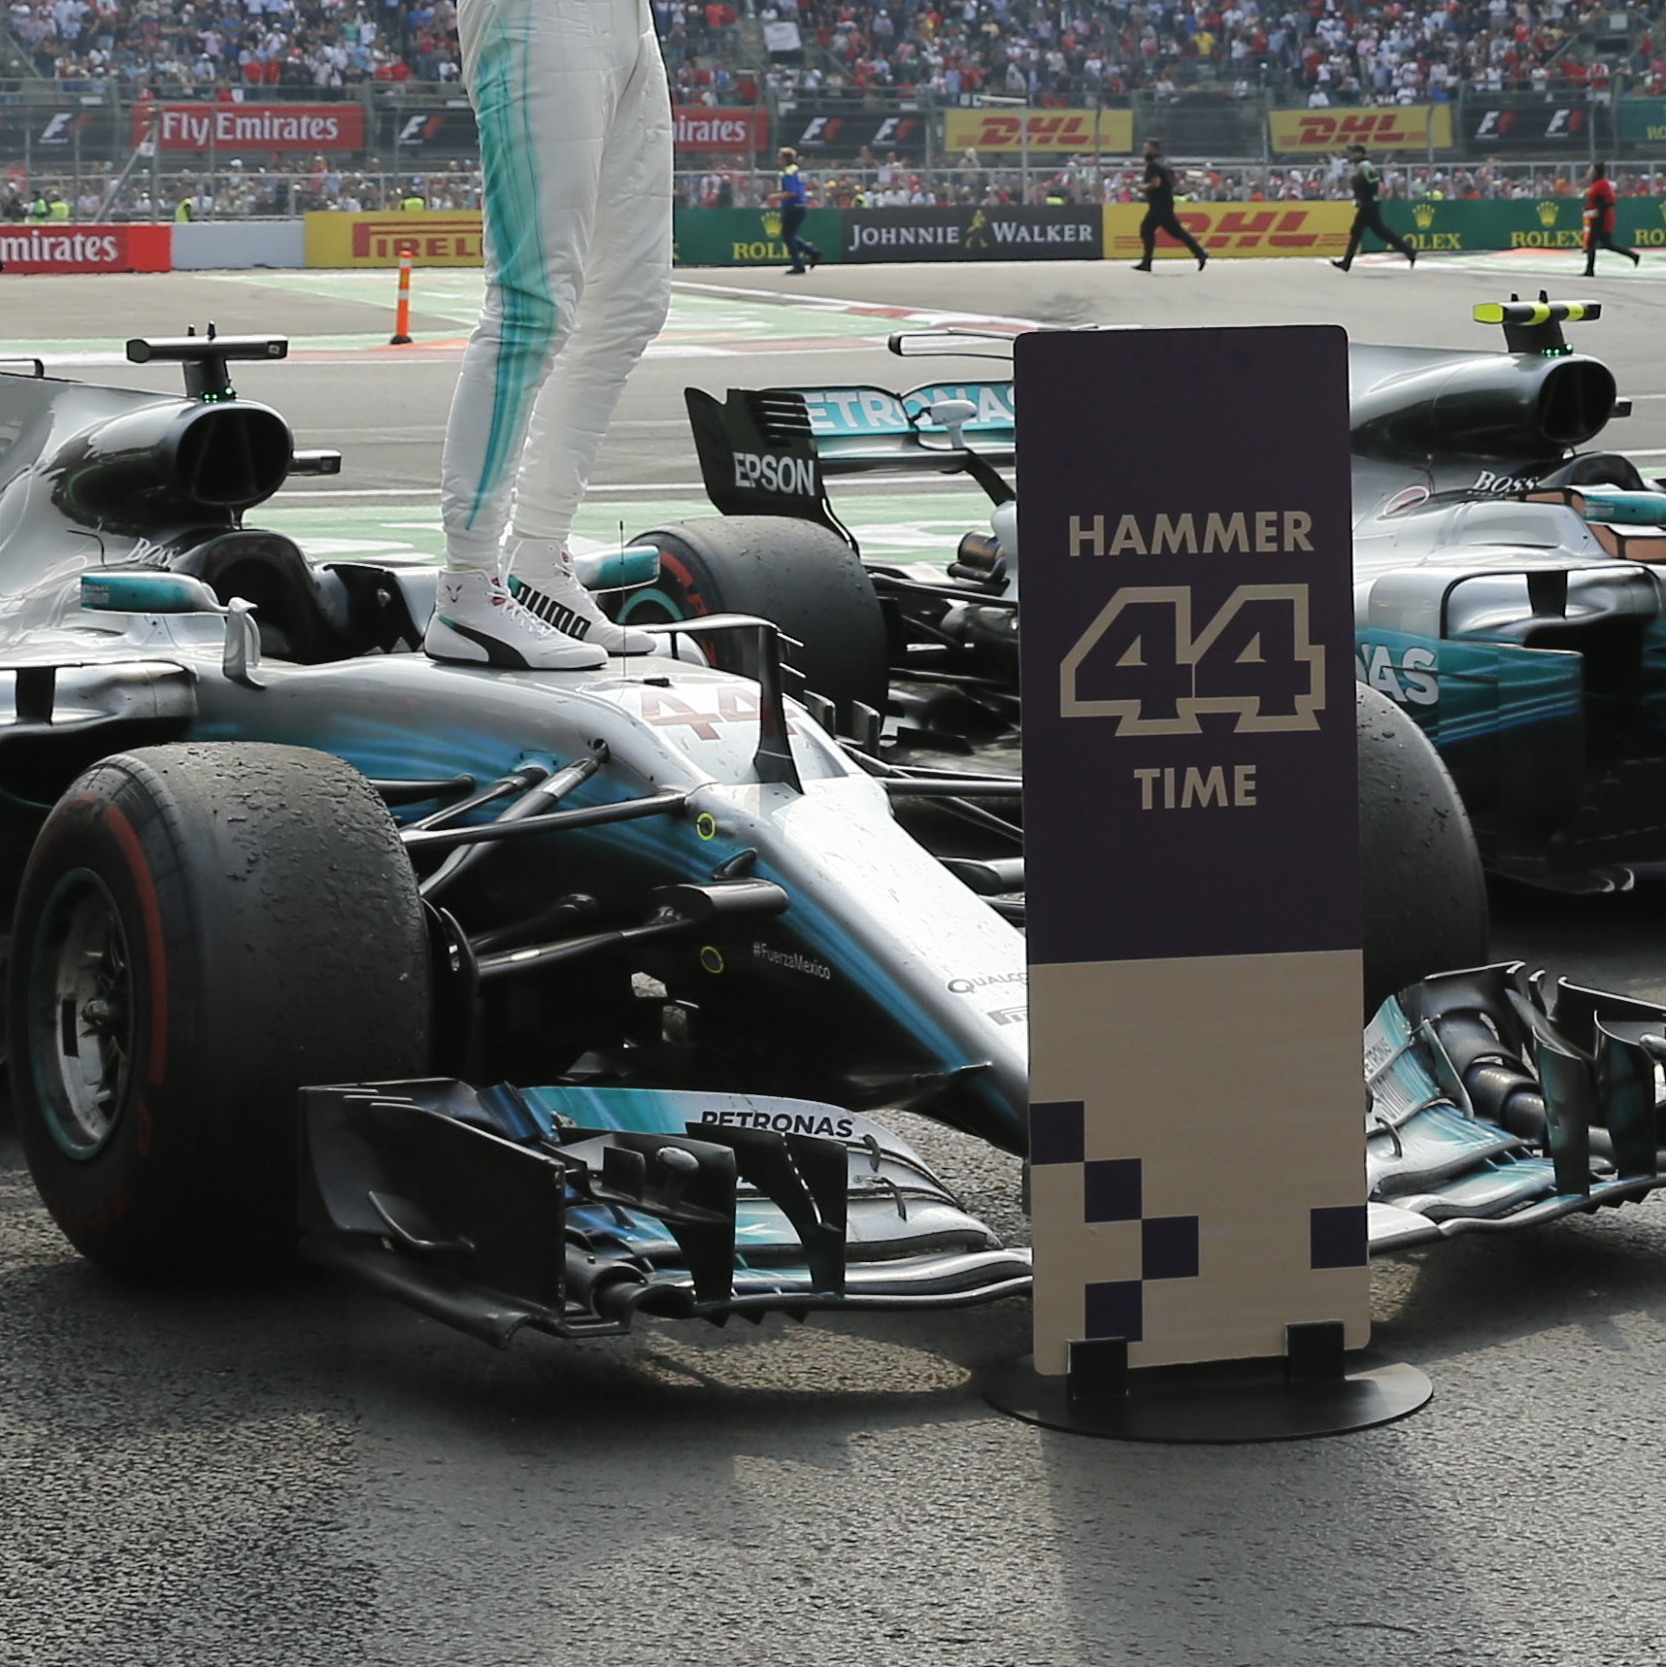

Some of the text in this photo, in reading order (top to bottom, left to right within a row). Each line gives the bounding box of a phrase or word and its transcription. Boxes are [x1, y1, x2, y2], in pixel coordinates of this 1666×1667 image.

[162, 110, 339, 146] Fly Emirates
[979, 117, 1090, 145] DHL
[1299, 114, 1406, 144] DHL
[849, 222, 1093, 252] JOHNNIE WALKER
[1153, 211, 1318, 248] DHL
[1510, 230, 1585, 248] ROLEX
[733, 452, 815, 497] EPSON
[1068, 510, 1314, 557] HAMMER
[1060, 584, 1325, 737] 44
[1134, 765, 1258, 810] TIME
[752, 941, 831, 980] #FuerzaMexico
[702, 1111, 854, 1137] PETRONAS
